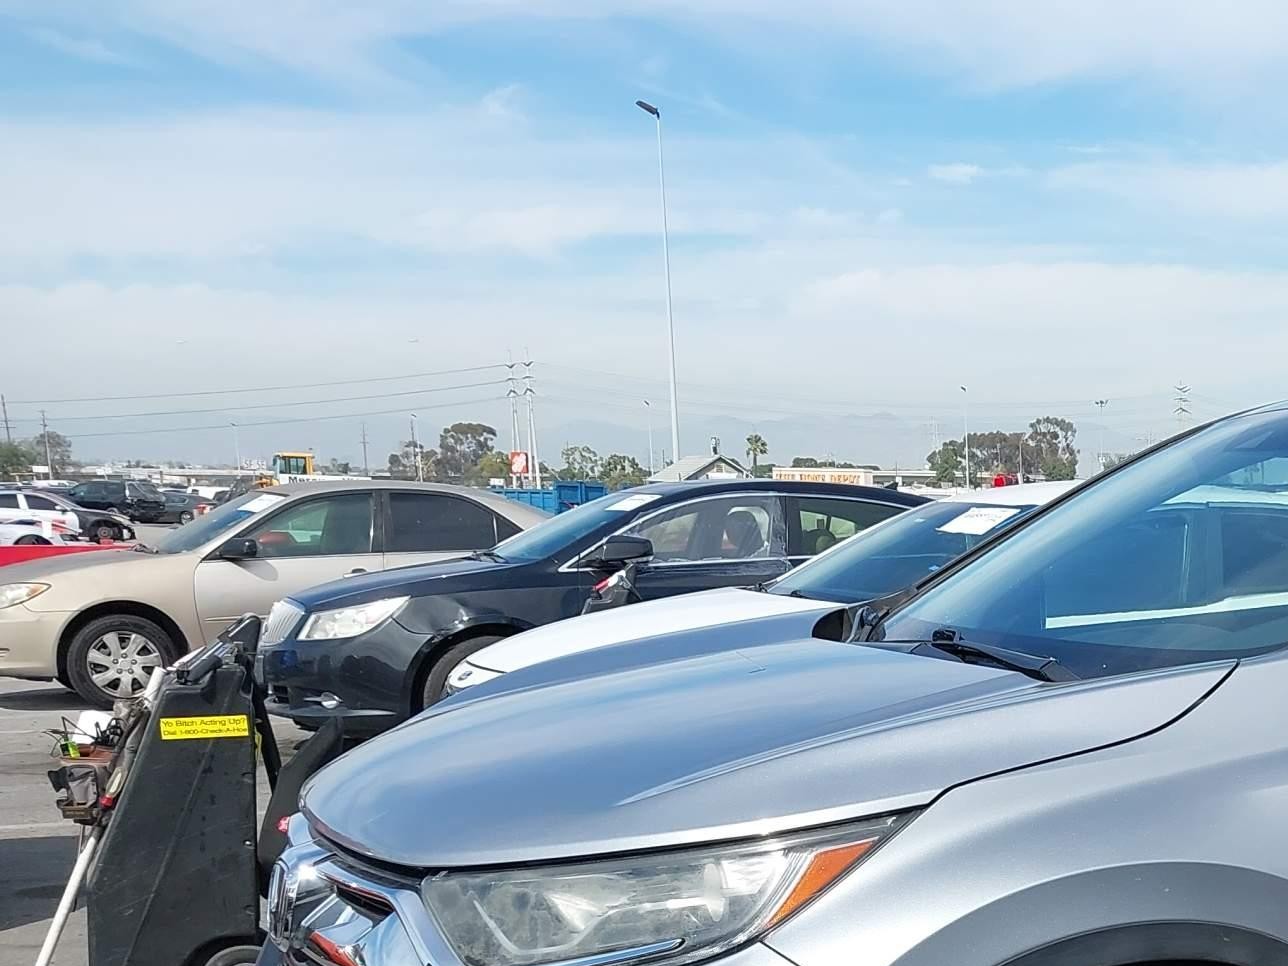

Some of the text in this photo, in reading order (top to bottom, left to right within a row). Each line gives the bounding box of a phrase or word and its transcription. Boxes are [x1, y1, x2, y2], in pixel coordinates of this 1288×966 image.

[162, 717, 246, 728] Yo Bitch Acting Up?
